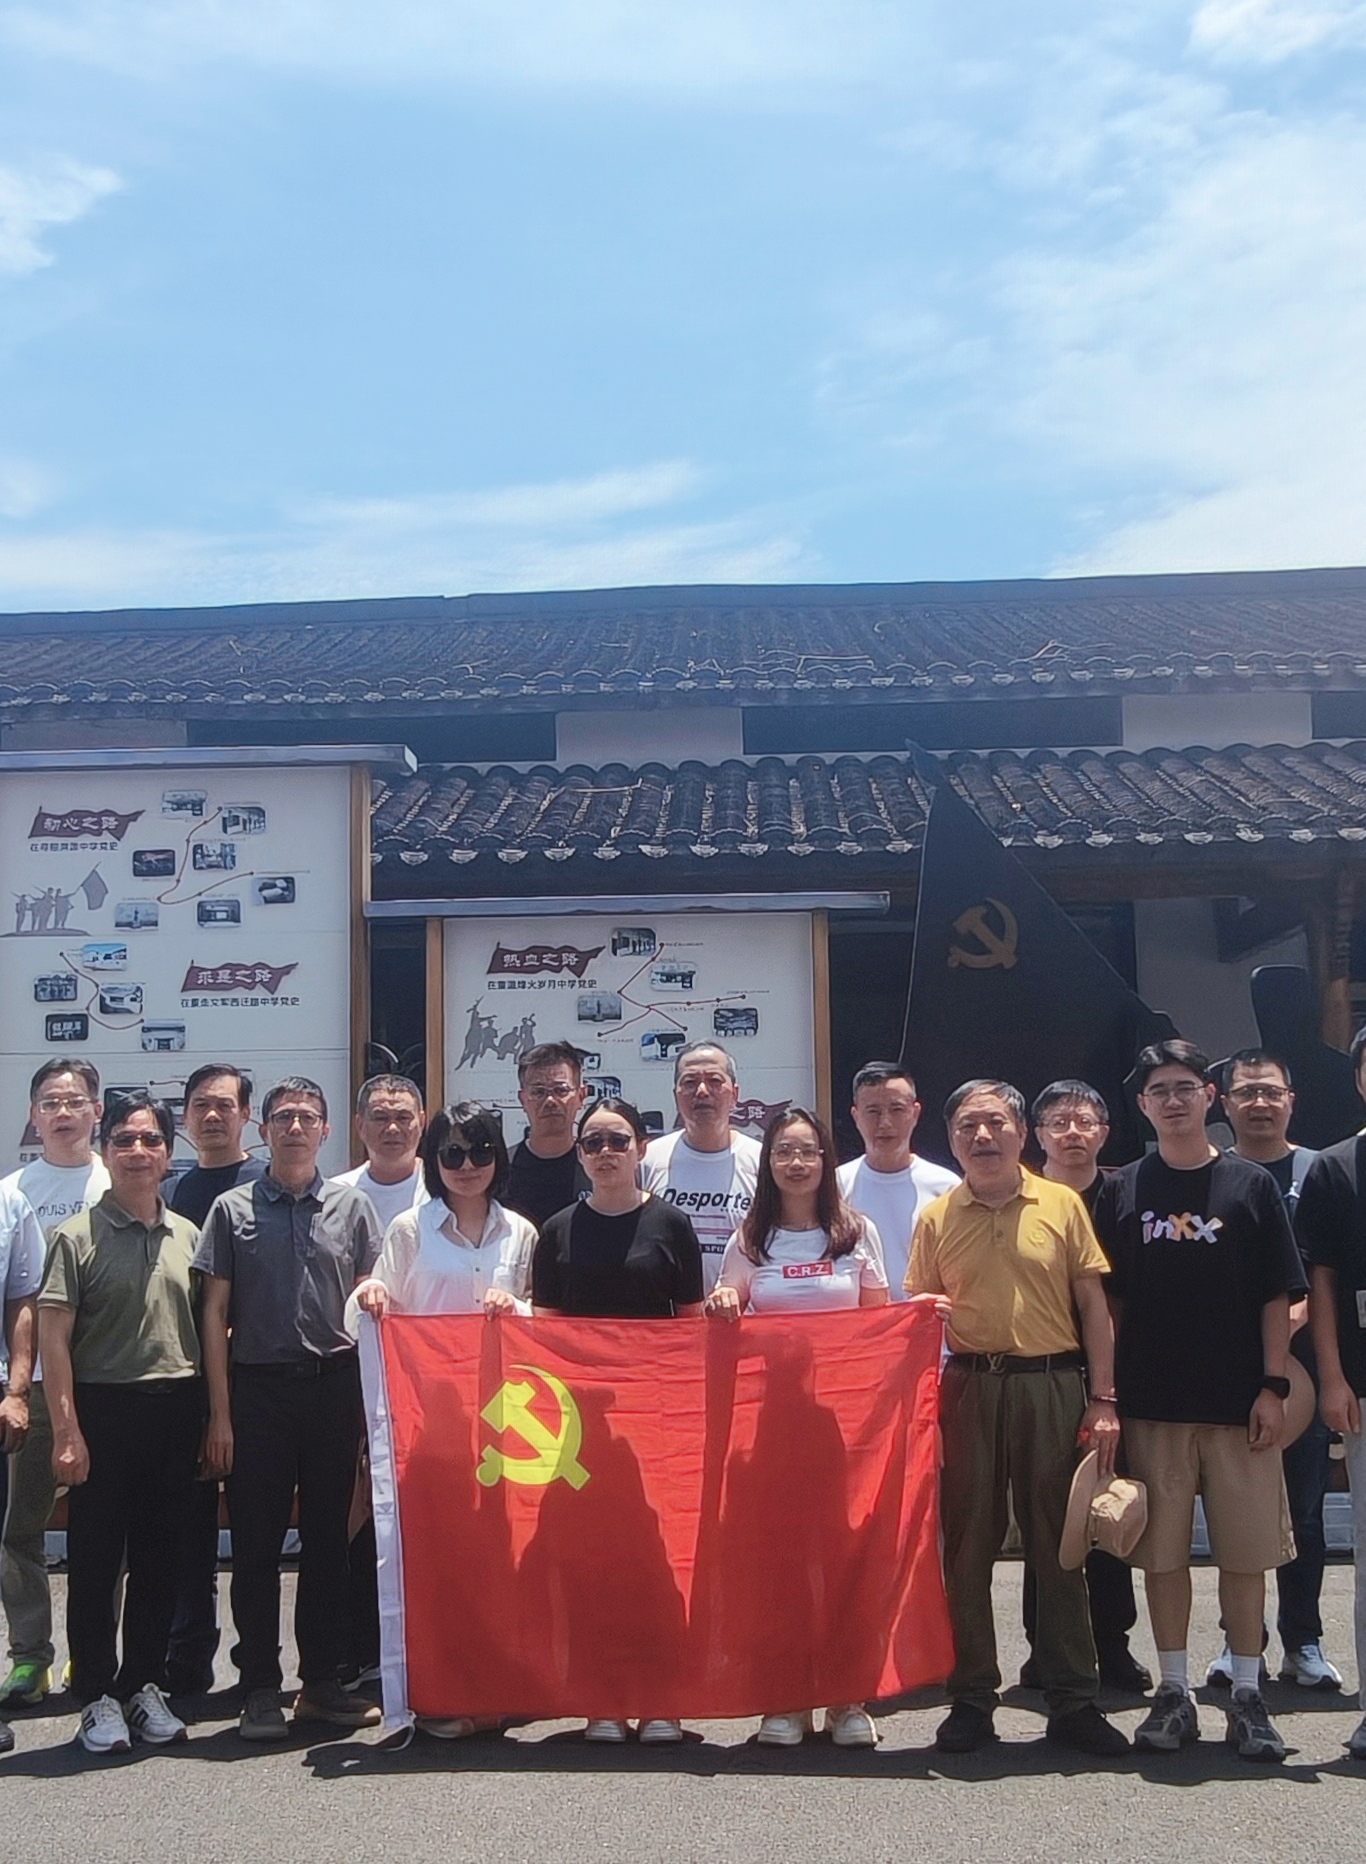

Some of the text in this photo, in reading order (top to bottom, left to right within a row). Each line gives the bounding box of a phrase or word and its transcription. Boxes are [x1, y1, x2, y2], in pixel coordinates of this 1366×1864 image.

[43, 816, 119, 831] 初心之路
[503, 952, 579, 968] 热血之路
[196, 968, 273, 985] 求是之路
[37, 1203, 67, 1217] OUIS
